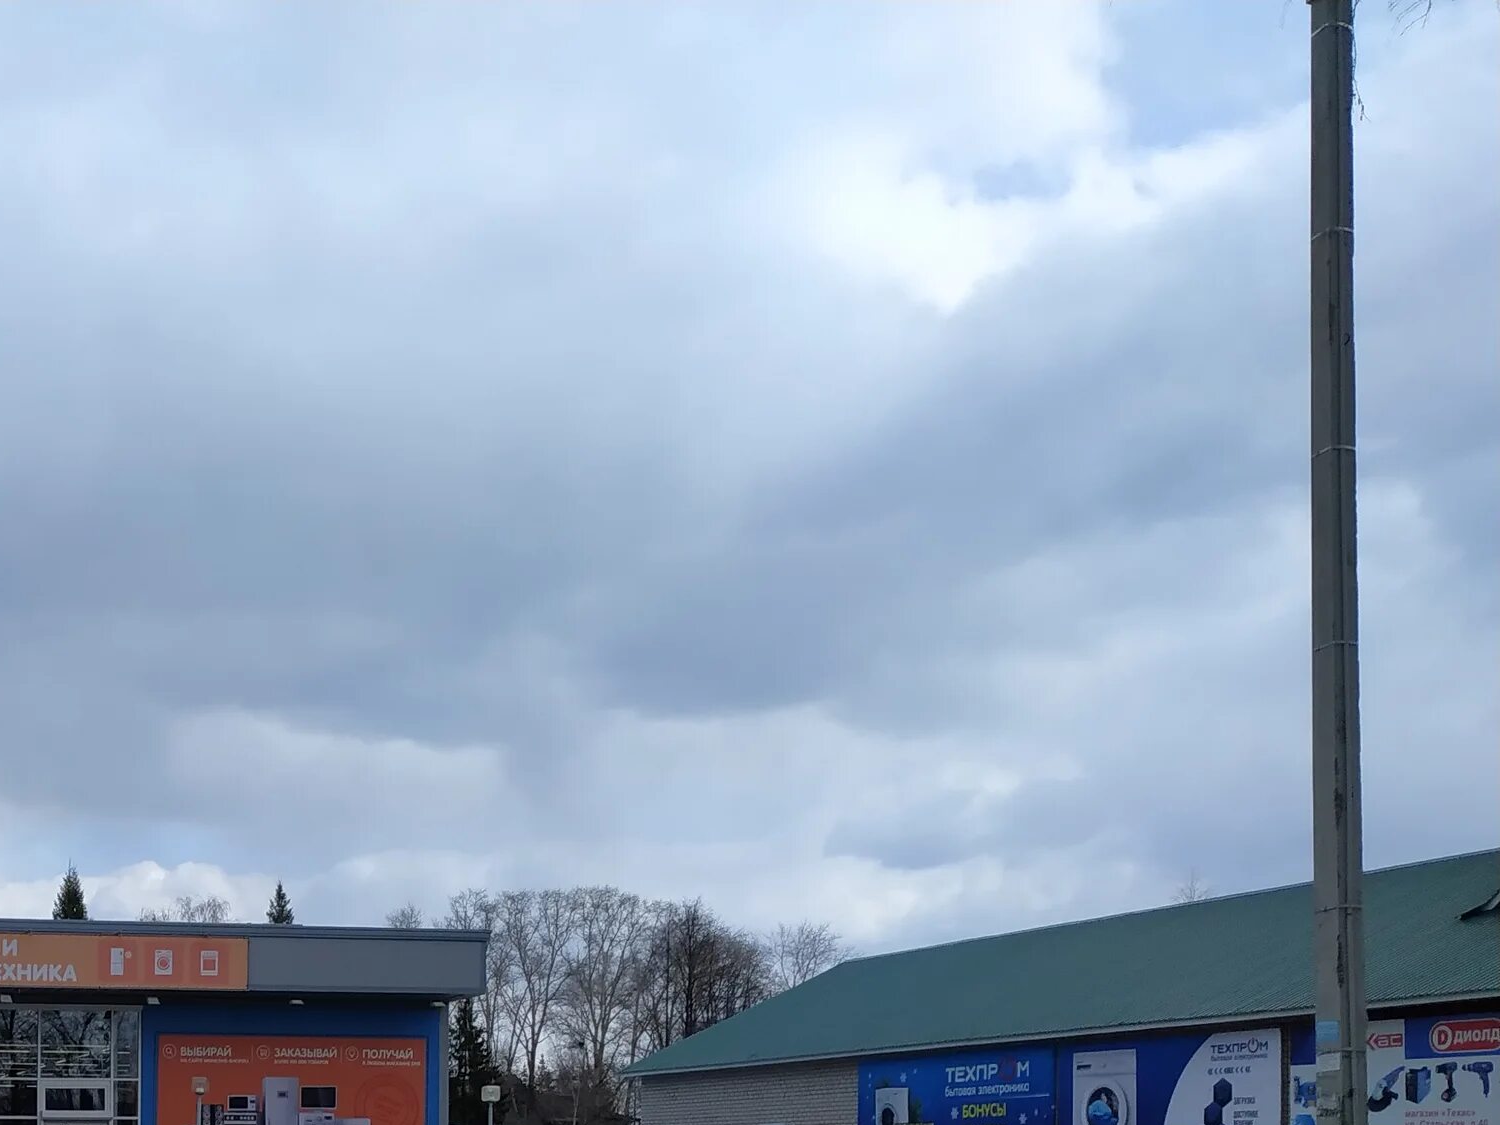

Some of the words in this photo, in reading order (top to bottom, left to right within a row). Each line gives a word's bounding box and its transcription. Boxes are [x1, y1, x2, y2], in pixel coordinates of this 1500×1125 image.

[3, 939, 18, 956] И
[180, 1045, 232, 1057] ВЫБИРАЙ
[274, 1047, 338, 1058] ЗАКАЗЫВАЙ
[362, 1048, 414, 1059] ПОЛУЧАЙ
[945, 1086, 976, 1097] бытовая
[977, 1083, 1030, 1096] электроника
[962, 1103, 1007, 1118] БОНУСЫ
[1405, 1110, 1439, 1118] магазин
